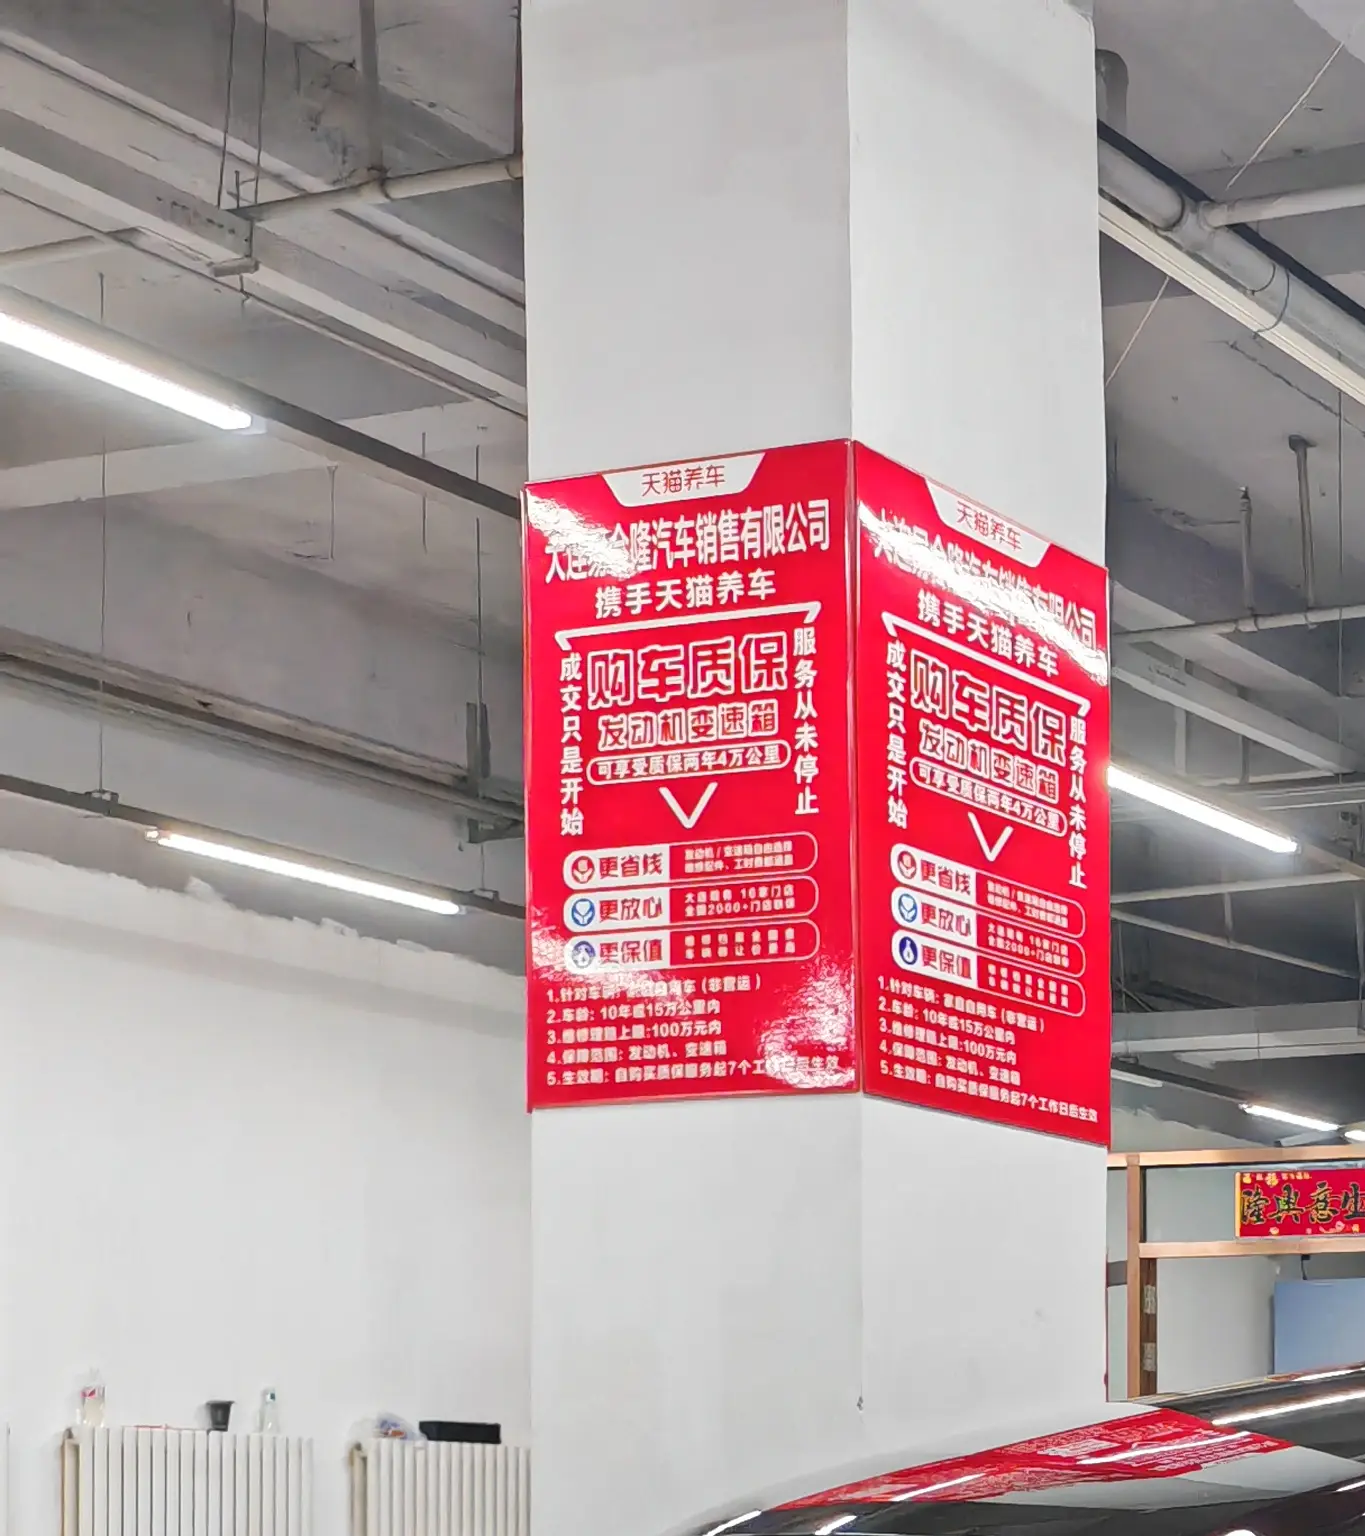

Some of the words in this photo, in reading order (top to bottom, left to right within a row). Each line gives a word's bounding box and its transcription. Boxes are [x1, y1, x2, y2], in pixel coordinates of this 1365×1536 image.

[641, 465, 725, 497] 天猫养车
[957, 500, 1022, 552] 天猫养车
[595, 567, 776, 620] 携手天猫养车
[917, 588, 1060, 678] 携手天猫养车
[587, 632, 788, 710] 购车质保
[597, 698, 779, 752] 发动机变速箱
[792, 626, 819, 816] 服务从未停止
[909, 648, 1066, 767] 购车质保
[559, 652, 584, 836] 成交只是开始
[886, 640, 908, 830] 成交只是开始
[919, 717, 1059, 805] 发动机变速箱
[596, 745, 782, 781] 可享受质保两年4万公里
[918, 763, 1061, 832] 可享受质保两年4万公里
[1067, 714, 1088, 890] 服务从未停止
[599, 852, 663, 879] 更省钱
[920, 858, 972, 897] 更省钱
[599, 895, 663, 922] 更放心
[920, 901, 972, 938] 更放心
[599, 938, 663, 965] 更保值
[920, 944, 973, 981] 更保值
